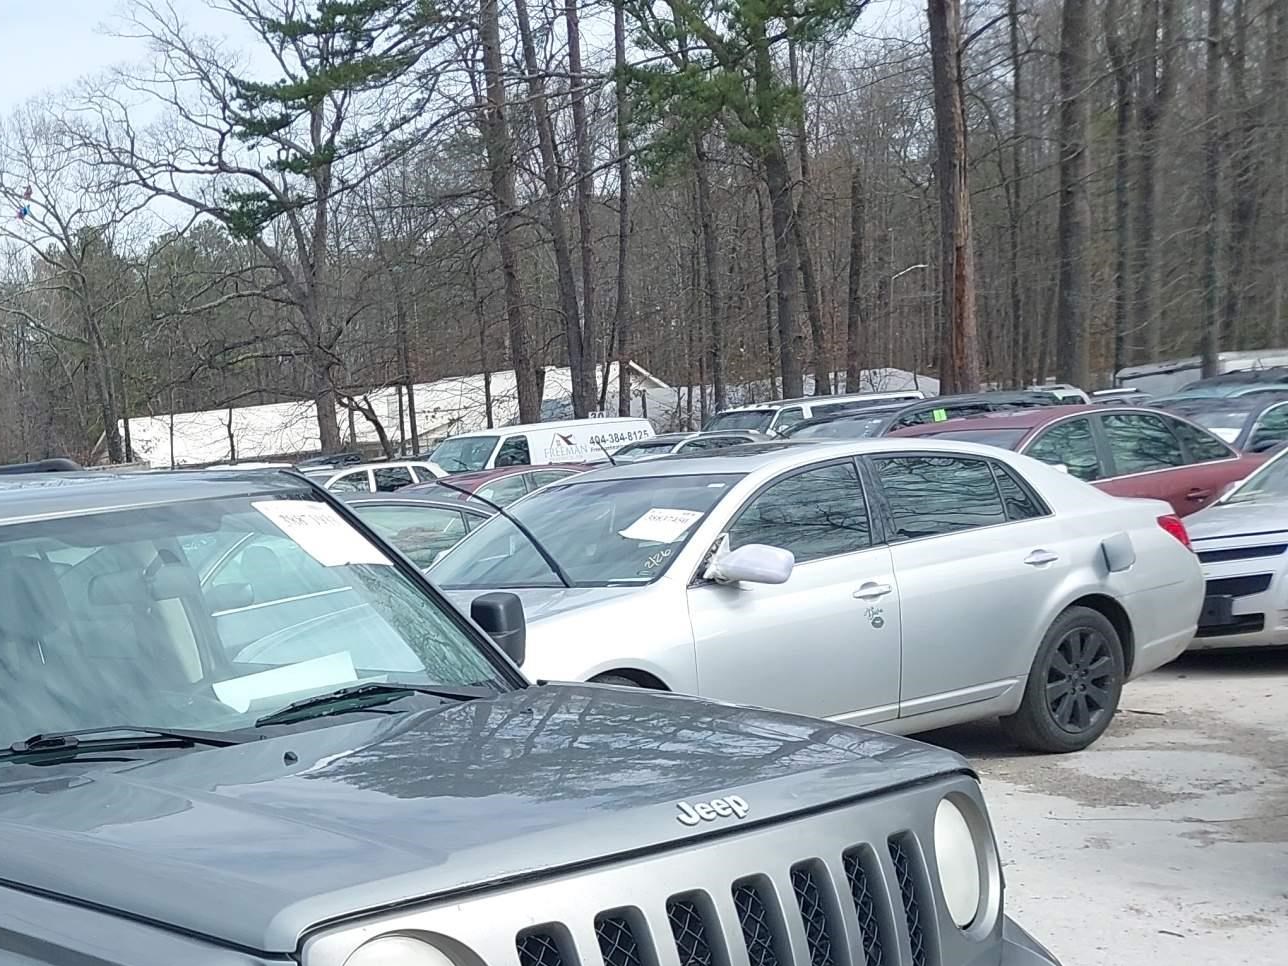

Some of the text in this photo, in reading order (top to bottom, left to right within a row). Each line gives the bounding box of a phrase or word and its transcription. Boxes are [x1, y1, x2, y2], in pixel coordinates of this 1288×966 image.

[589, 430, 649, 446] 404-384-8125
[544, 445, 588, 459] FREEMAN
[644, 549, 672, 569] 2/26
[676, 795, 749, 826] Jeep
